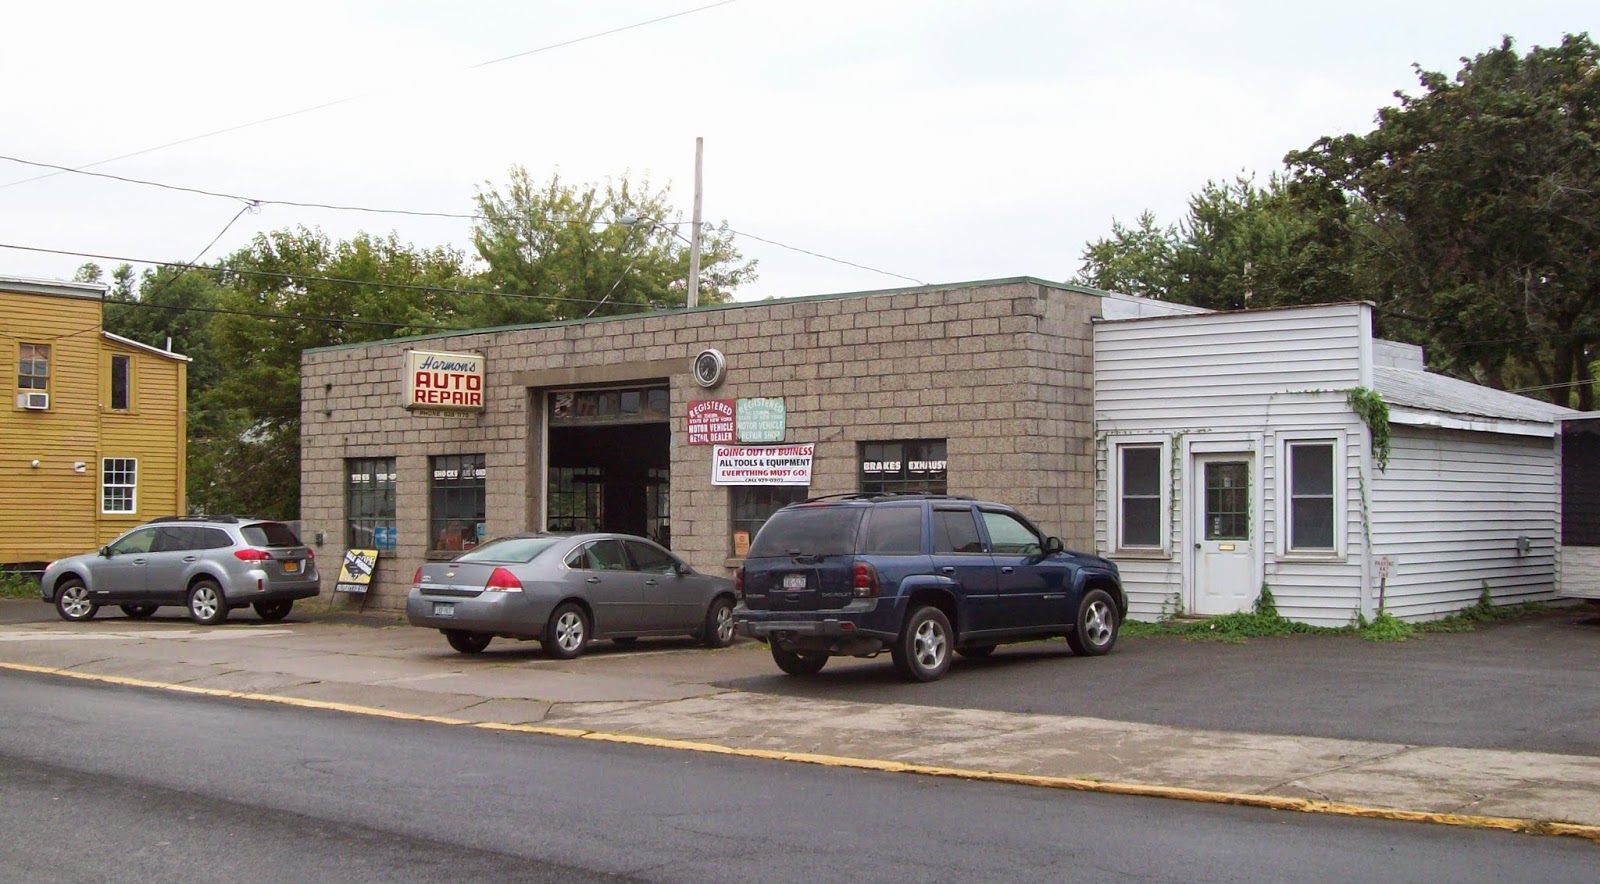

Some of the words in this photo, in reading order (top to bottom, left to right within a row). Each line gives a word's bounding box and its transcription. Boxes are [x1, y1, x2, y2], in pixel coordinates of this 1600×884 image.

[419, 356, 476, 372] Harmon's
[415, 371, 481, 391] AUTO
[414, 389, 482, 406] REPAIR
[689, 401, 733, 418] REGISTERED
[738, 399, 784, 414] REGISTERED
[689, 424, 708, 433] MOTOR
[710, 422, 734, 432] VEHICLE
[738, 421, 758, 430] MOTOR
[759, 420, 784, 430] VEHICLE
[689, 433, 709, 443] RETAIL
[710, 432, 733, 442] DEALER
[741, 430, 761, 440] REPAIR
[763, 430, 780, 439] SHOP
[717, 448, 745, 457] GOING
[746, 448, 764, 457] OUT
[765, 448, 777, 456] OF
[777, 446, 813, 456] BUINESS
[719, 459, 733, 467] ALL
[734, 459, 758, 467] TOOLS
[758, 459, 765, 467] &
[766, 458, 811, 468] EQUIPMENT
[863, 461, 901, 470] BRAKES
[908, 460, 947, 470] EXHAUST
